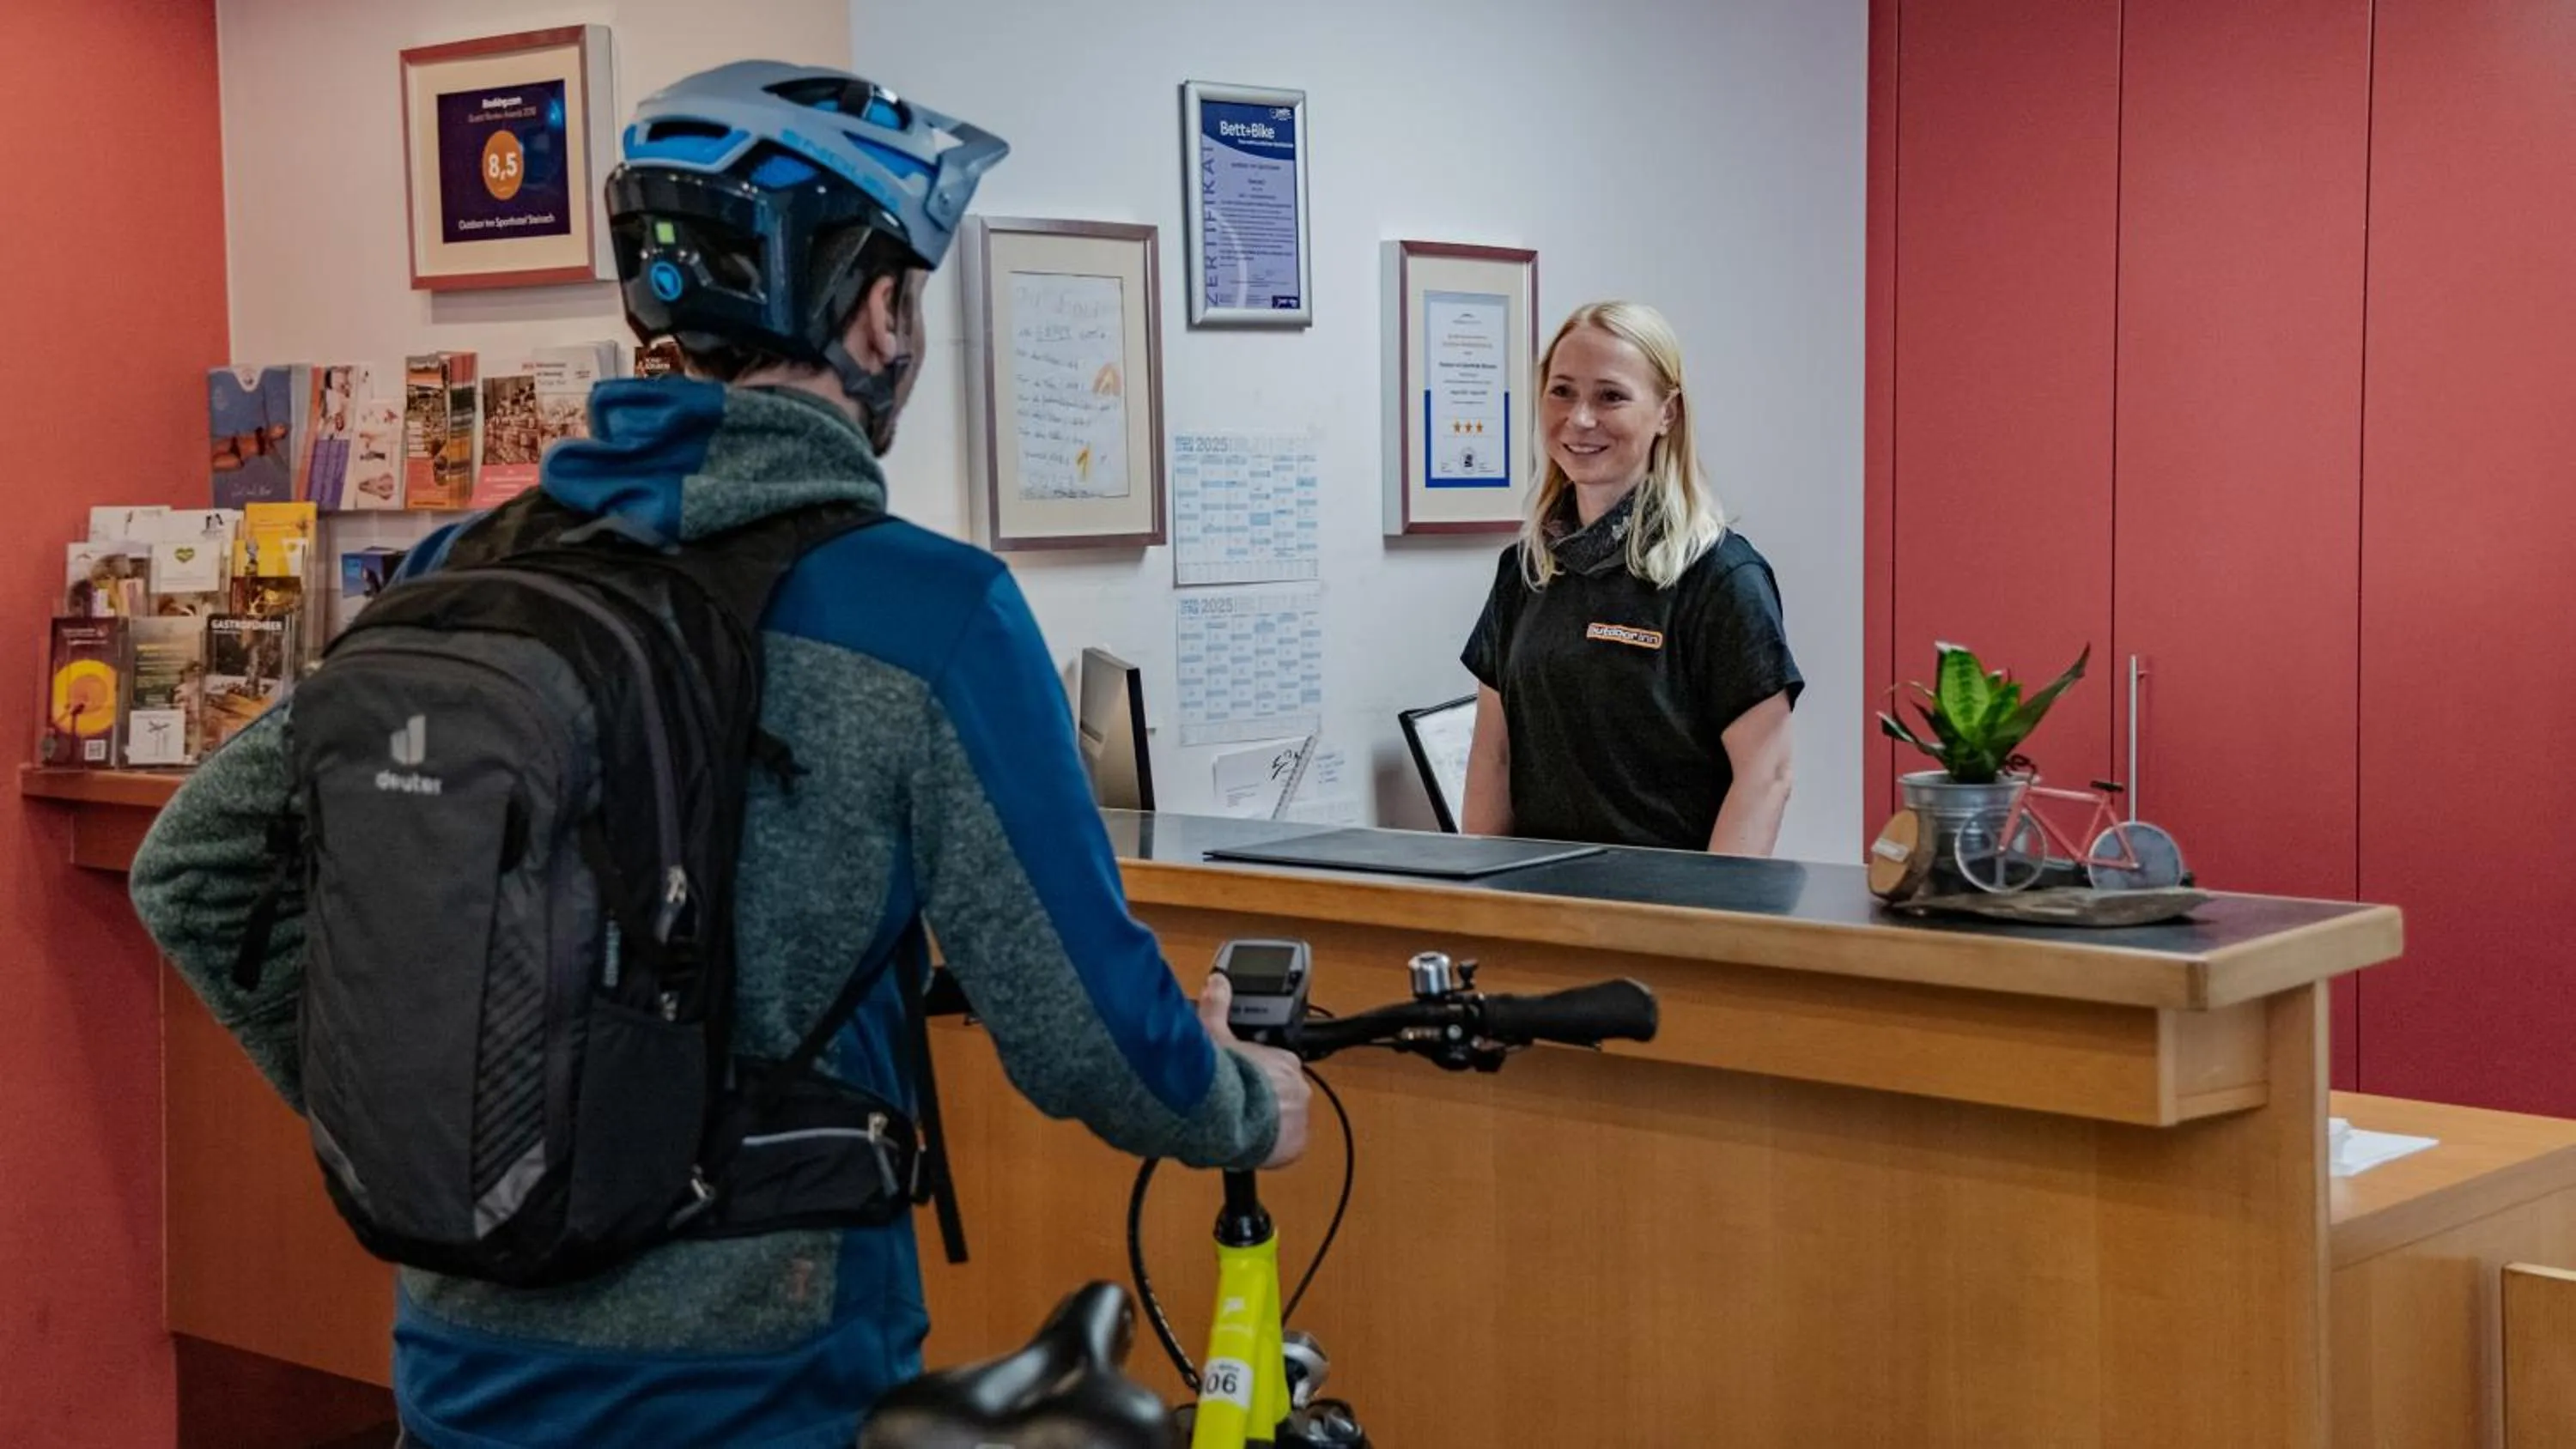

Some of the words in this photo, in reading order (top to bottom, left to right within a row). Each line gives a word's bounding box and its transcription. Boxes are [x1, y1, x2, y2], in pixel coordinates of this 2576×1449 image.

[1219, 120, 1275, 139] Bett+Bike
[488, 152, 518, 180] 8,5
[1195, 436, 1229, 453] 2025
[1202, 597, 1234, 614] 2025
